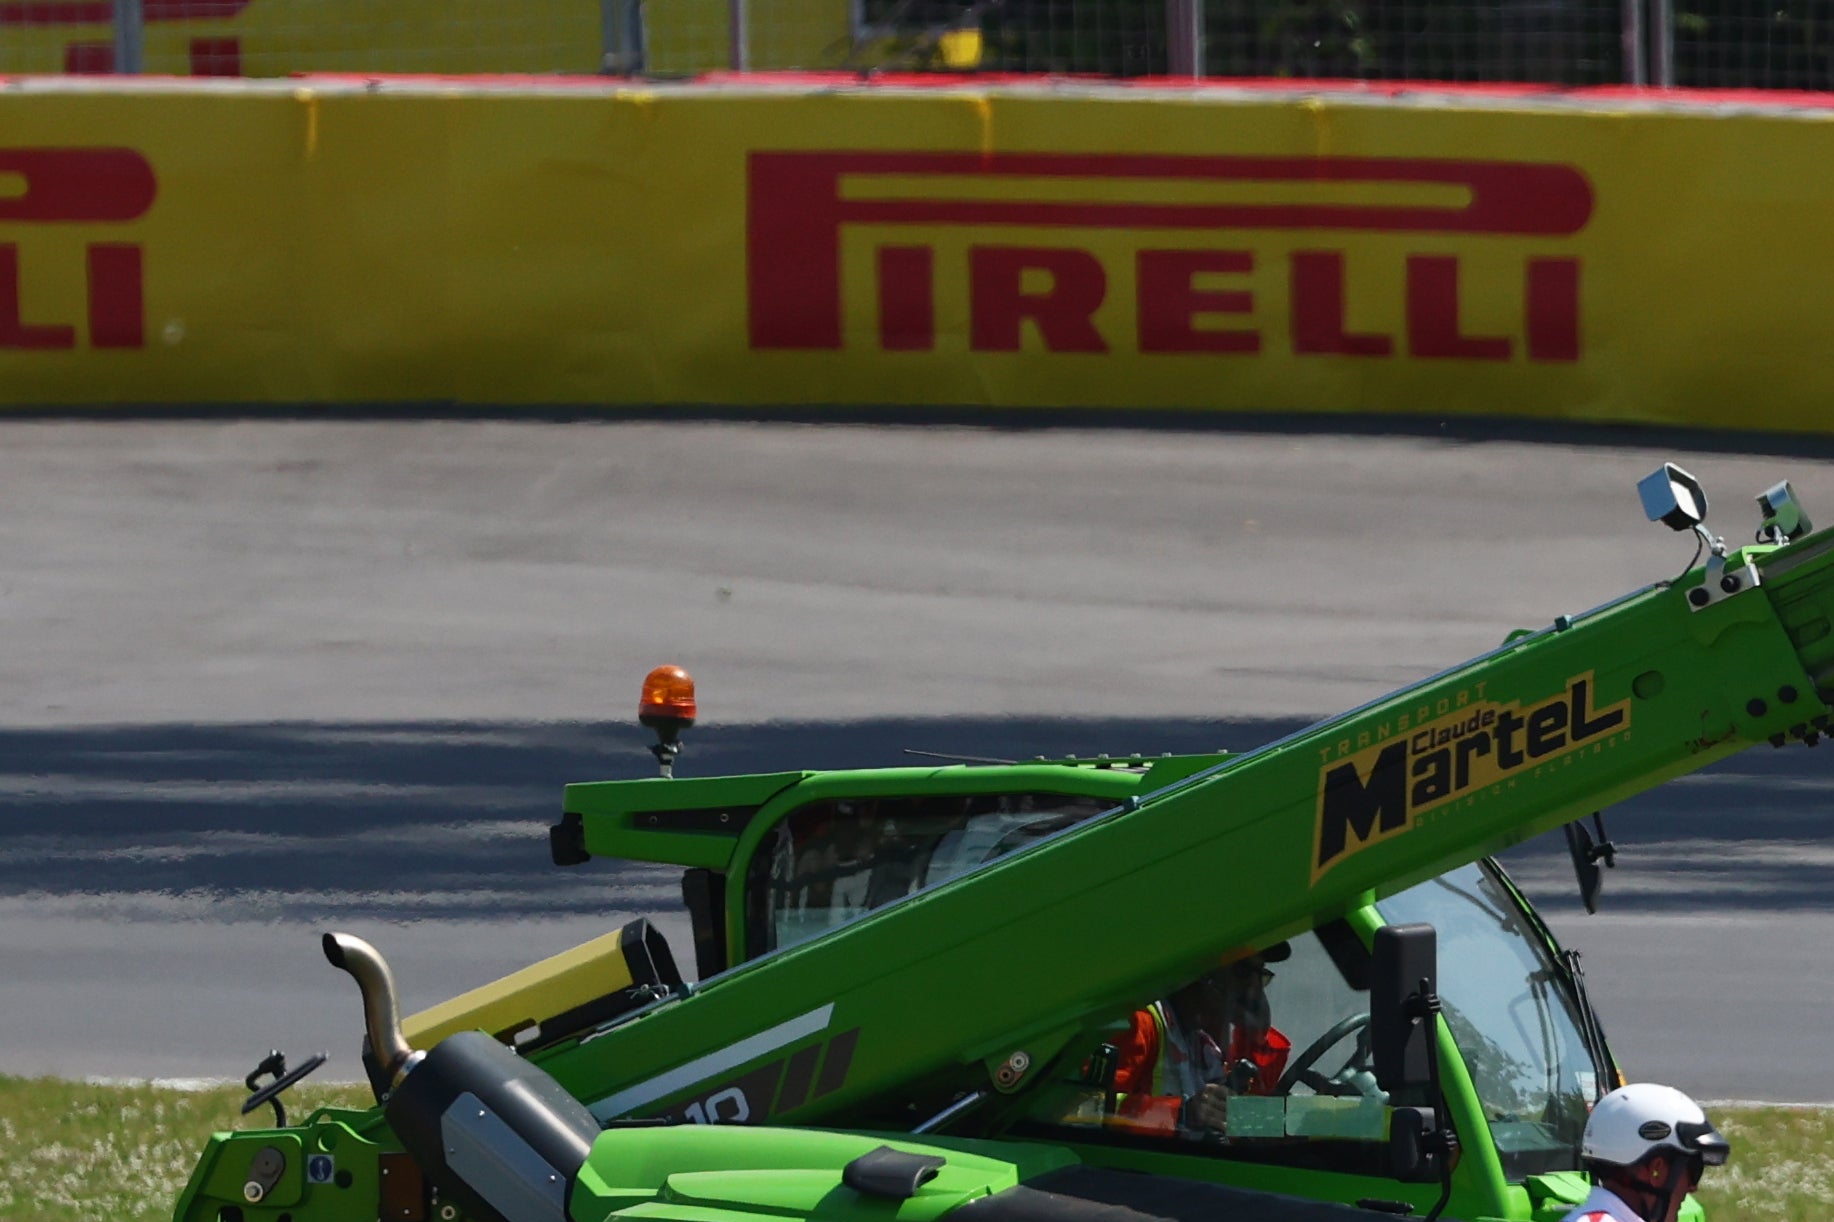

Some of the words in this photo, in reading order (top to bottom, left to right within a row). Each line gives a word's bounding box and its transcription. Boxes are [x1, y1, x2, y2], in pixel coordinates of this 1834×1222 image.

[747, 151, 1594, 362] PIRELLI
[1319, 680, 1490, 763] TRANSPORT
[1411, 708, 1496, 756] Claude
